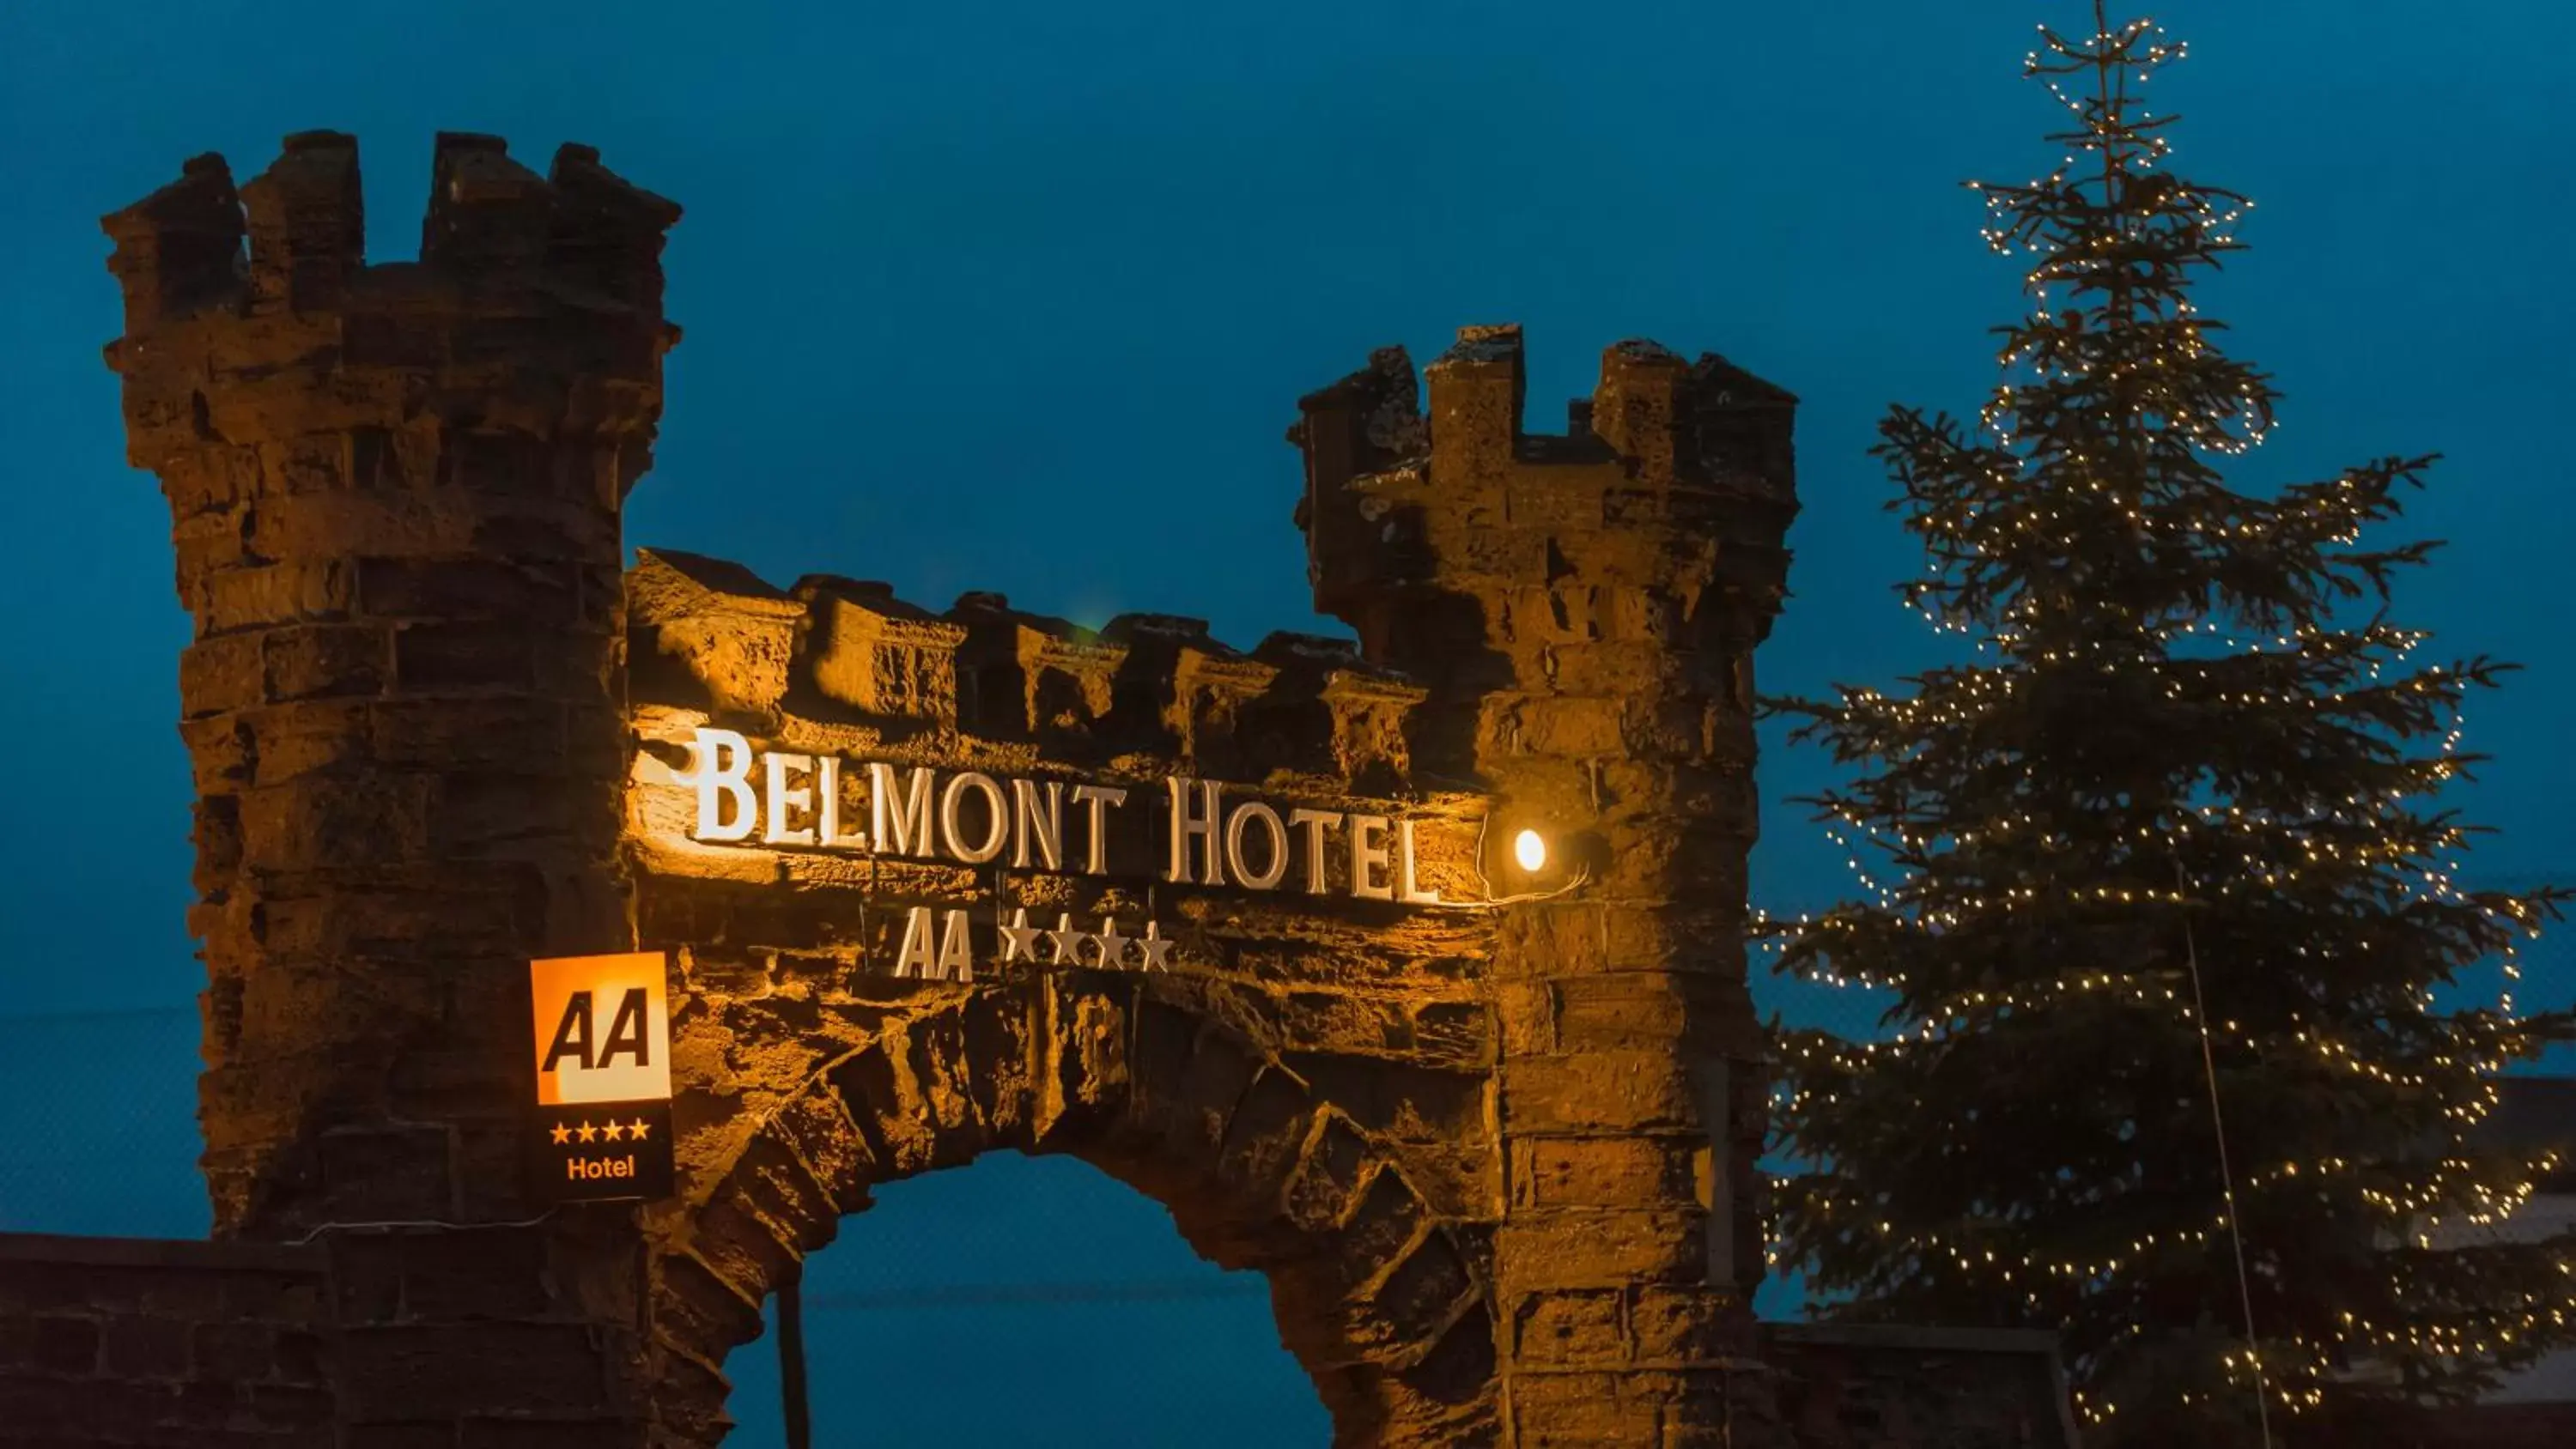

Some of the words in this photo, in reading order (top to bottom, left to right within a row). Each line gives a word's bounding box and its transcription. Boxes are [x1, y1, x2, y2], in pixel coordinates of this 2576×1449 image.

[694, 727, 1127, 876] BELMONT
[1167, 776, 1439, 904] HOTEL
[895, 906, 972, 983] AA
[542, 987, 649, 1072] AA
[568, 1155, 635, 1180] Hotel
